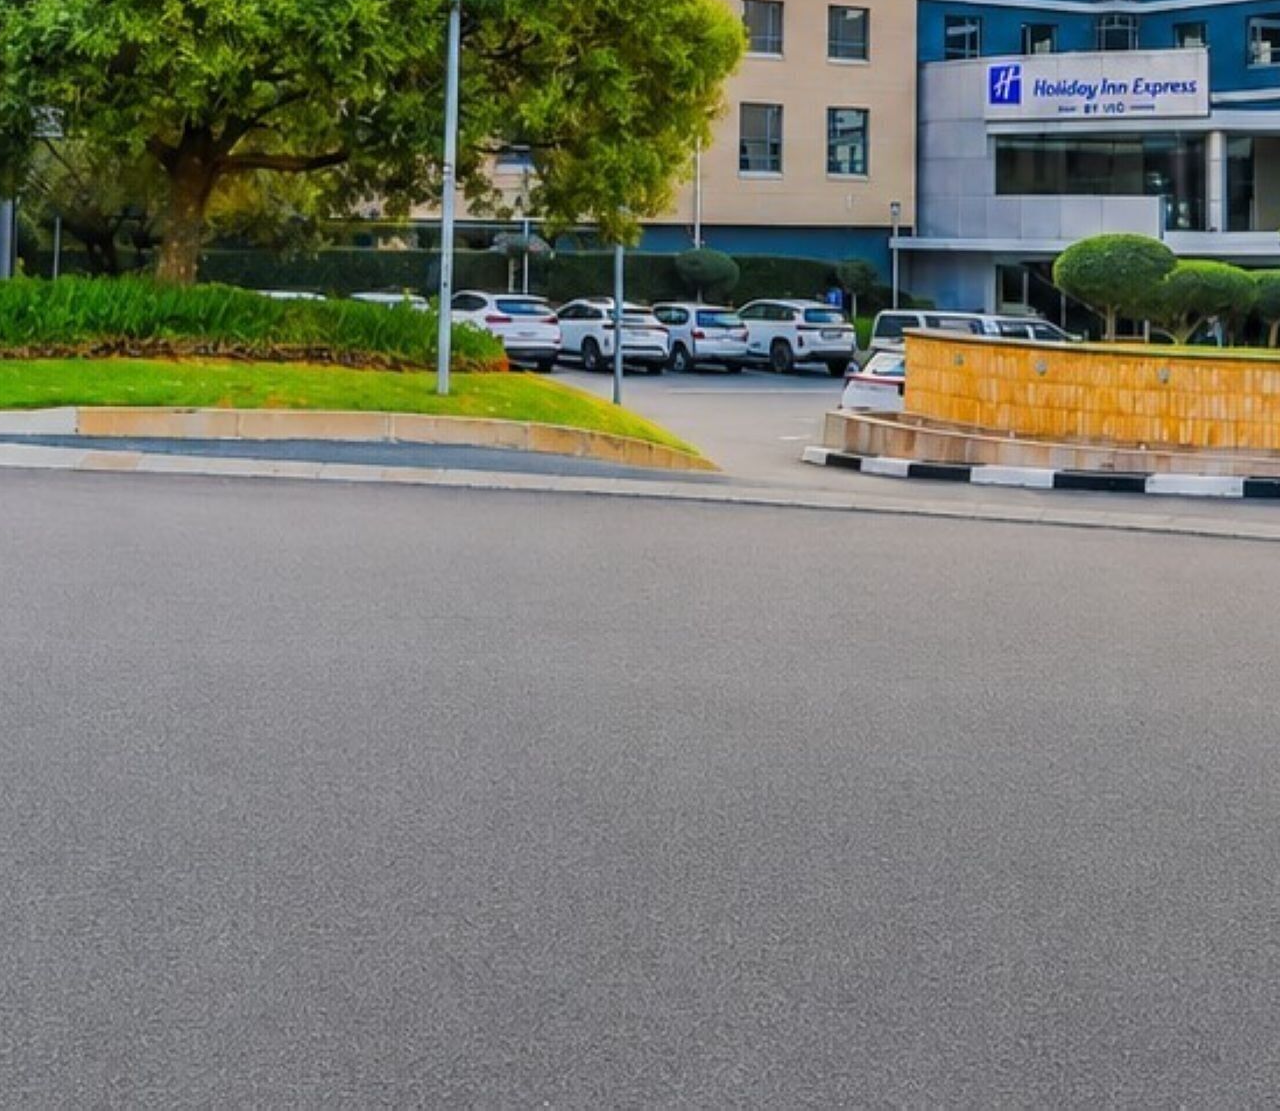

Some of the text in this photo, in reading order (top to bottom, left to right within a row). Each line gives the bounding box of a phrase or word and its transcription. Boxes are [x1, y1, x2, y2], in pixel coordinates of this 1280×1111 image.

[1033, 77, 1197, 99] Holiday Inn Express
